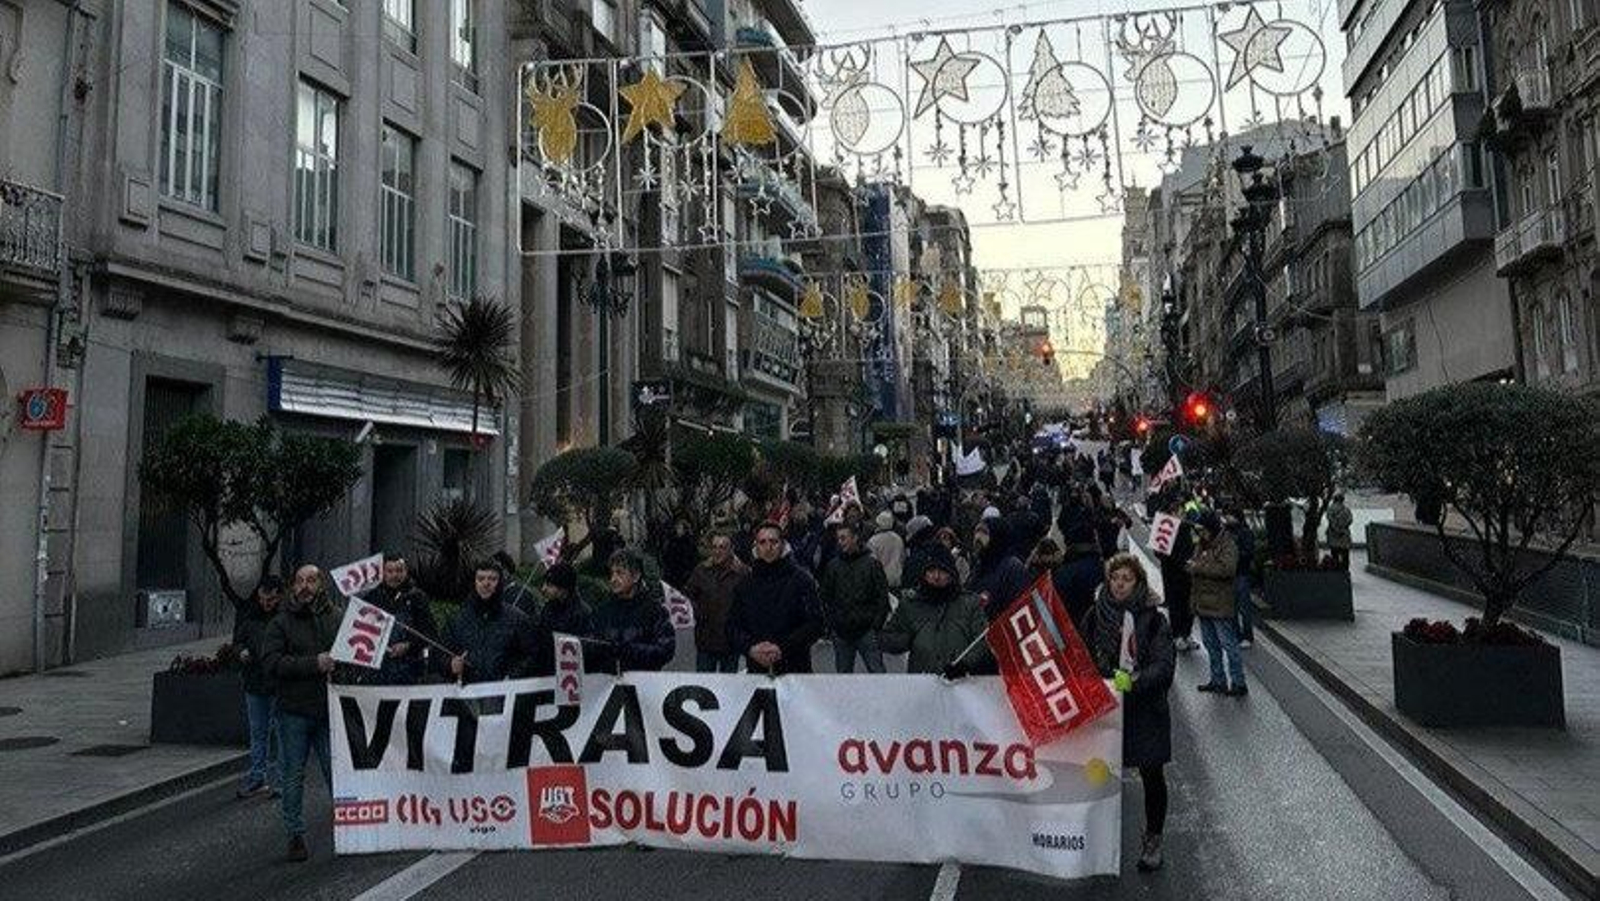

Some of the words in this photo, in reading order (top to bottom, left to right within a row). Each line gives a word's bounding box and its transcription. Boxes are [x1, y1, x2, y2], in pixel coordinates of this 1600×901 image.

[1009, 605, 1080, 724] CCOO
[339, 684, 789, 774] VITRASA
[839, 738, 1038, 780] avanza
[841, 781, 946, 799] GRUPO
[334, 806, 385, 821] CCOO
[589, 787, 797, 842] SOLUCIÓN
[1032, 832, 1085, 852] HORARIOS
